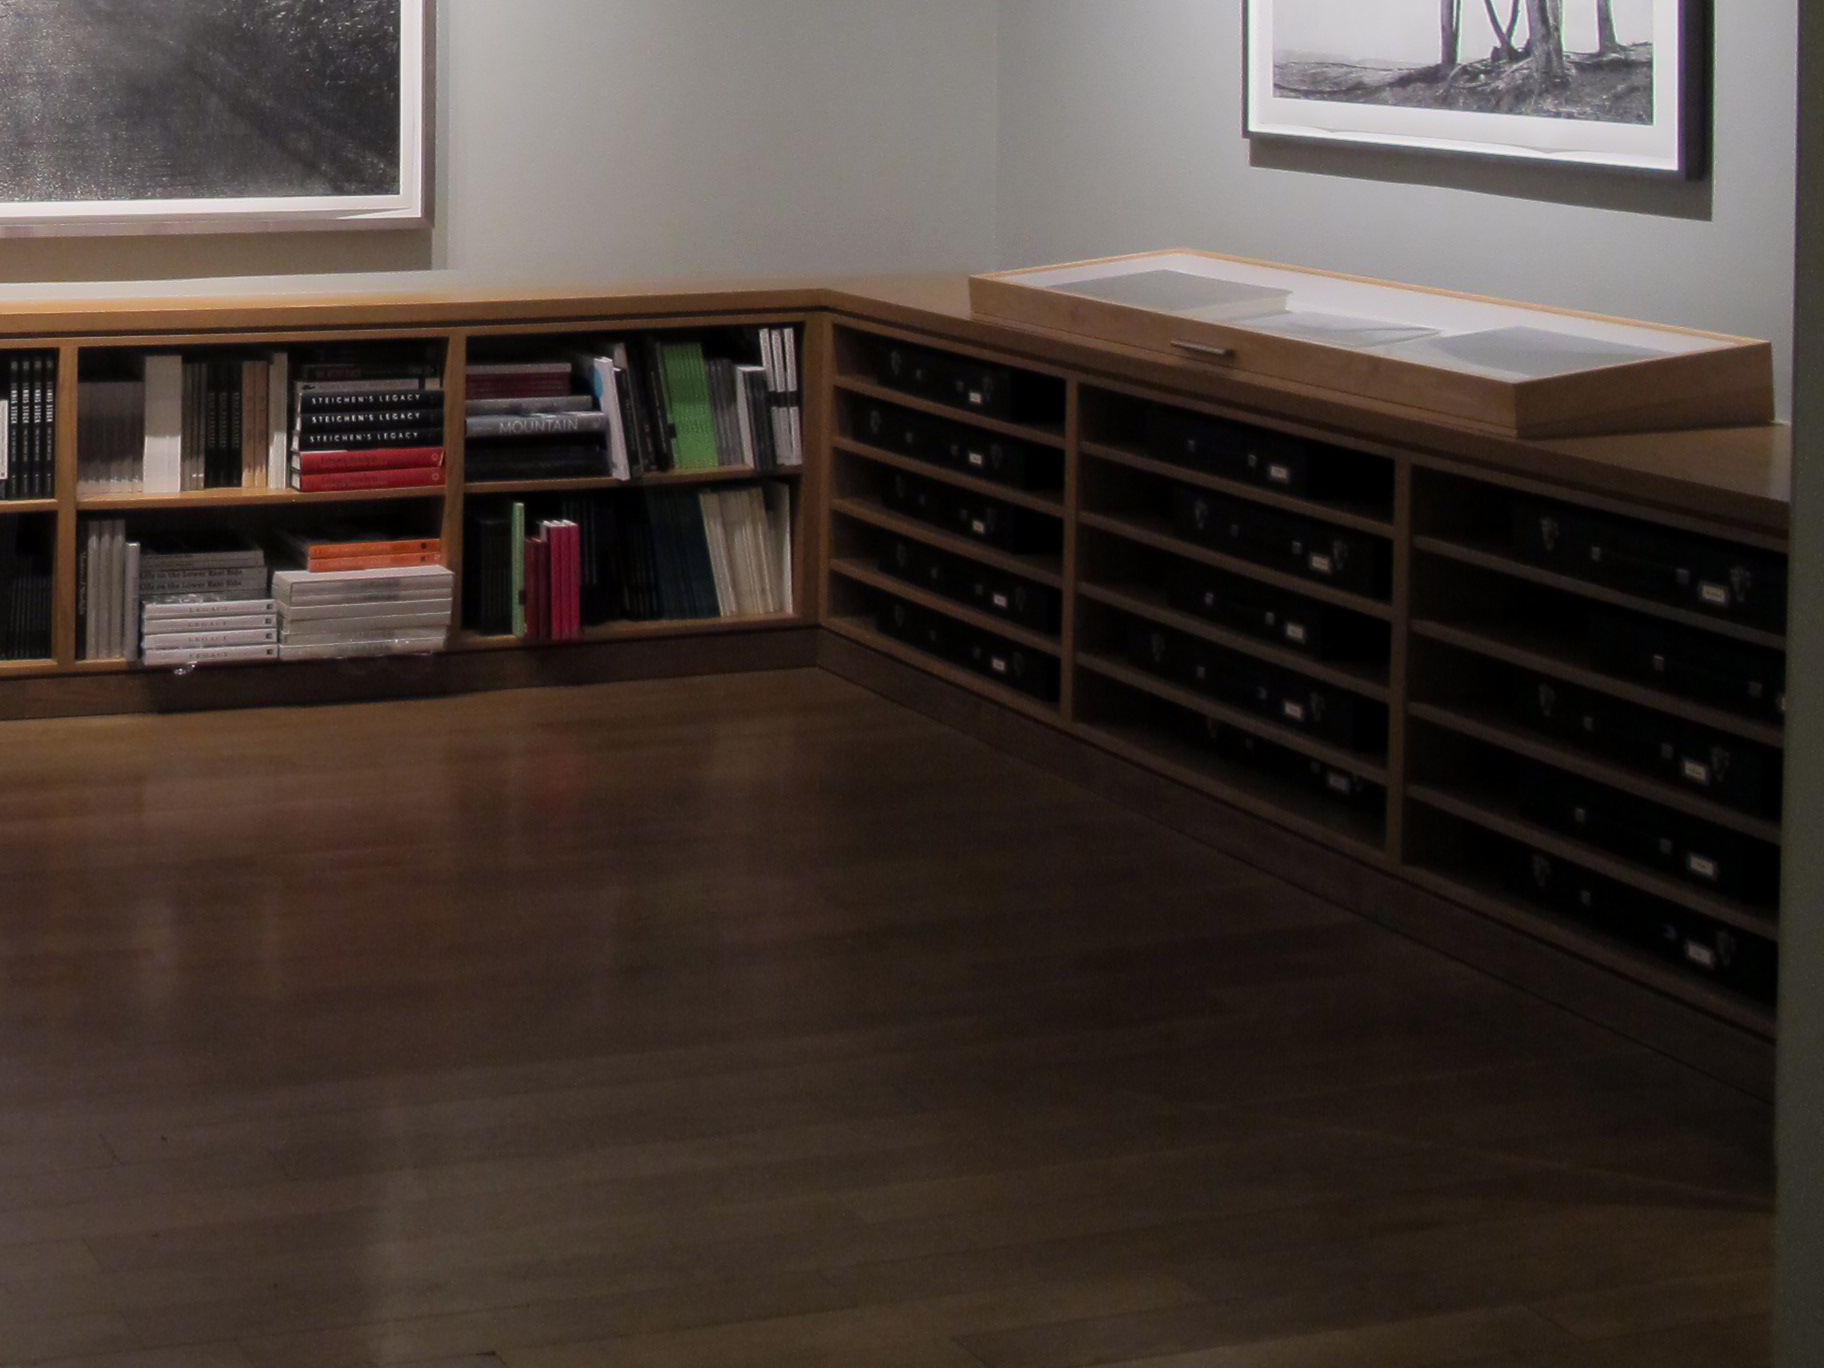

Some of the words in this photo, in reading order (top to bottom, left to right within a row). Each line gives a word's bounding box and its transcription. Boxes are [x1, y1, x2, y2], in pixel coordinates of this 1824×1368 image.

[311, 394, 374, 405] STEICHEN'S
[379, 393, 421, 402] LEGACY
[311, 413, 374, 424] STEICHEN'S
[379, 412, 421, 421] LEGACY
[499, 418, 578, 433] MOUNTAIN
[309, 432, 372, 443] STEICHEN'S
[377, 431, 419, 440] LEGACY
